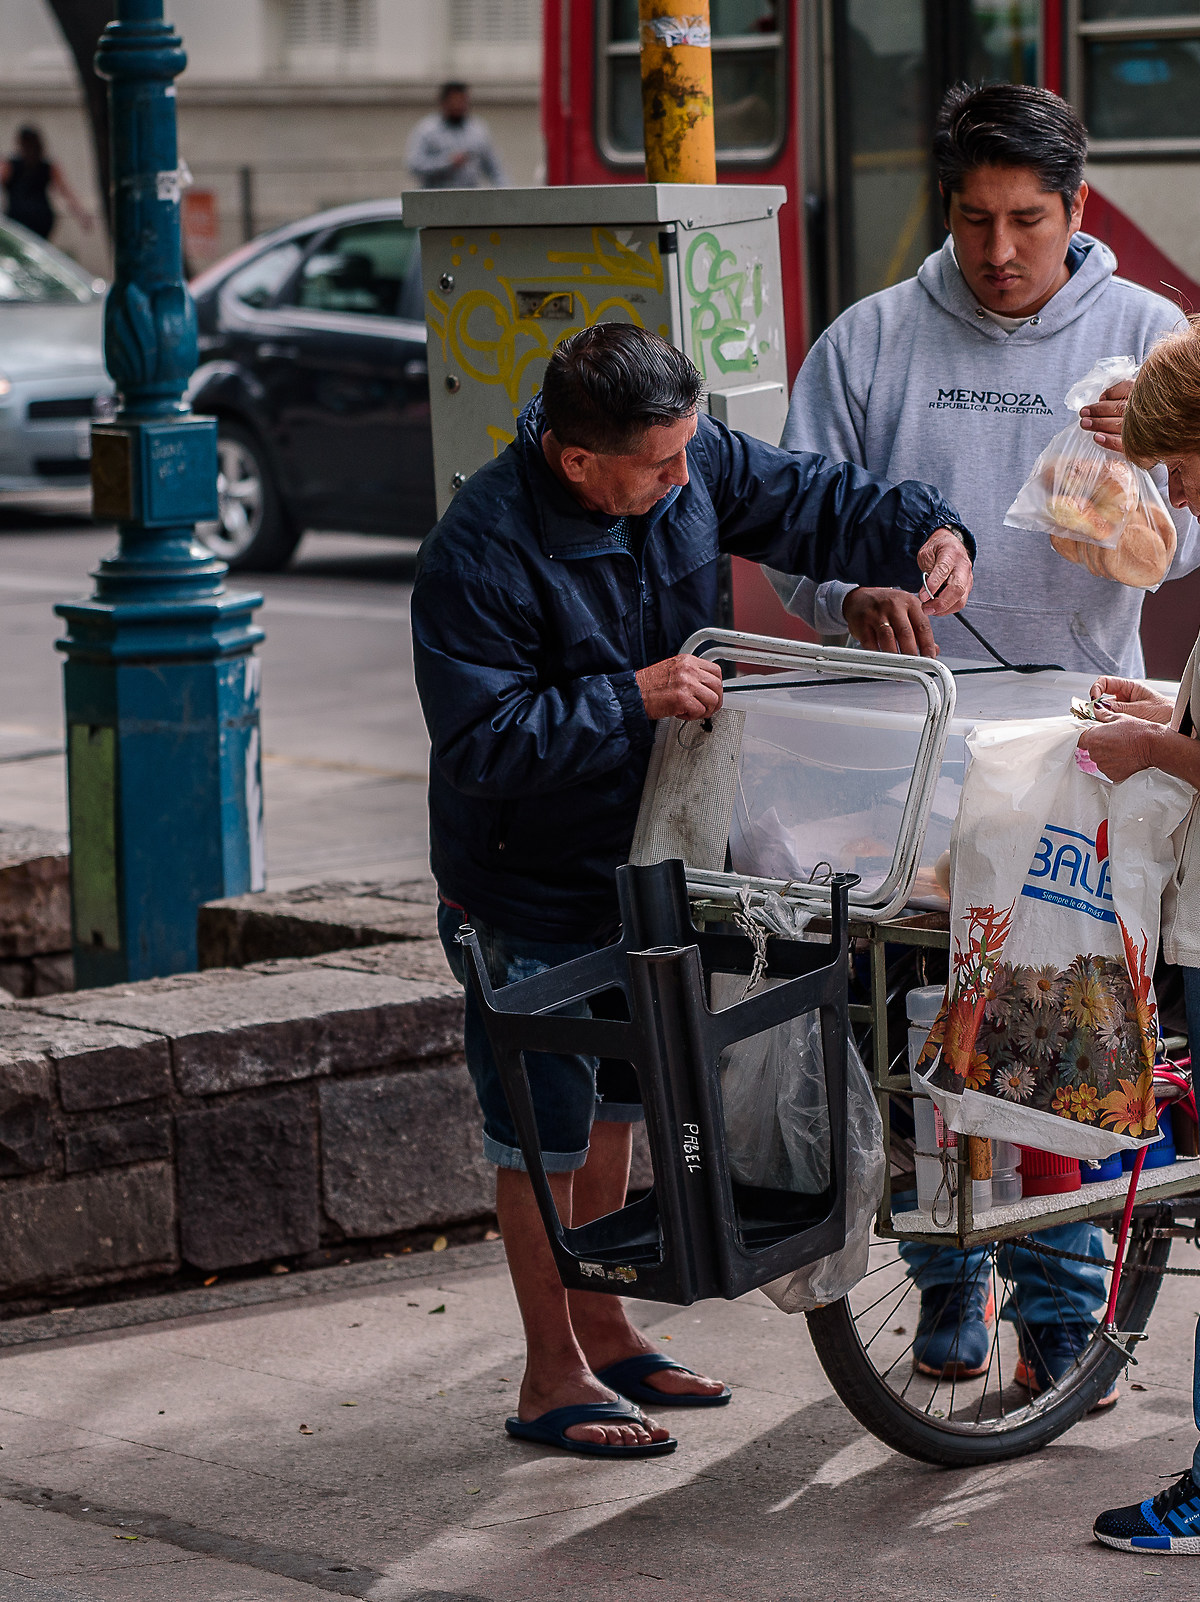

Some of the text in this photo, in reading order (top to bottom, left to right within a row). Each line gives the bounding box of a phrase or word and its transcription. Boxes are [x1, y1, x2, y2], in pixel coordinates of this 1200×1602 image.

[937, 388, 1047, 407] MENDOZA
[928, 401, 1054, 416] REPUBLICA ARGENTINA
[1041, 890, 1069, 906] Siempre
[1069, 898, 1076, 908] le
[1076, 901, 1087, 911] da
